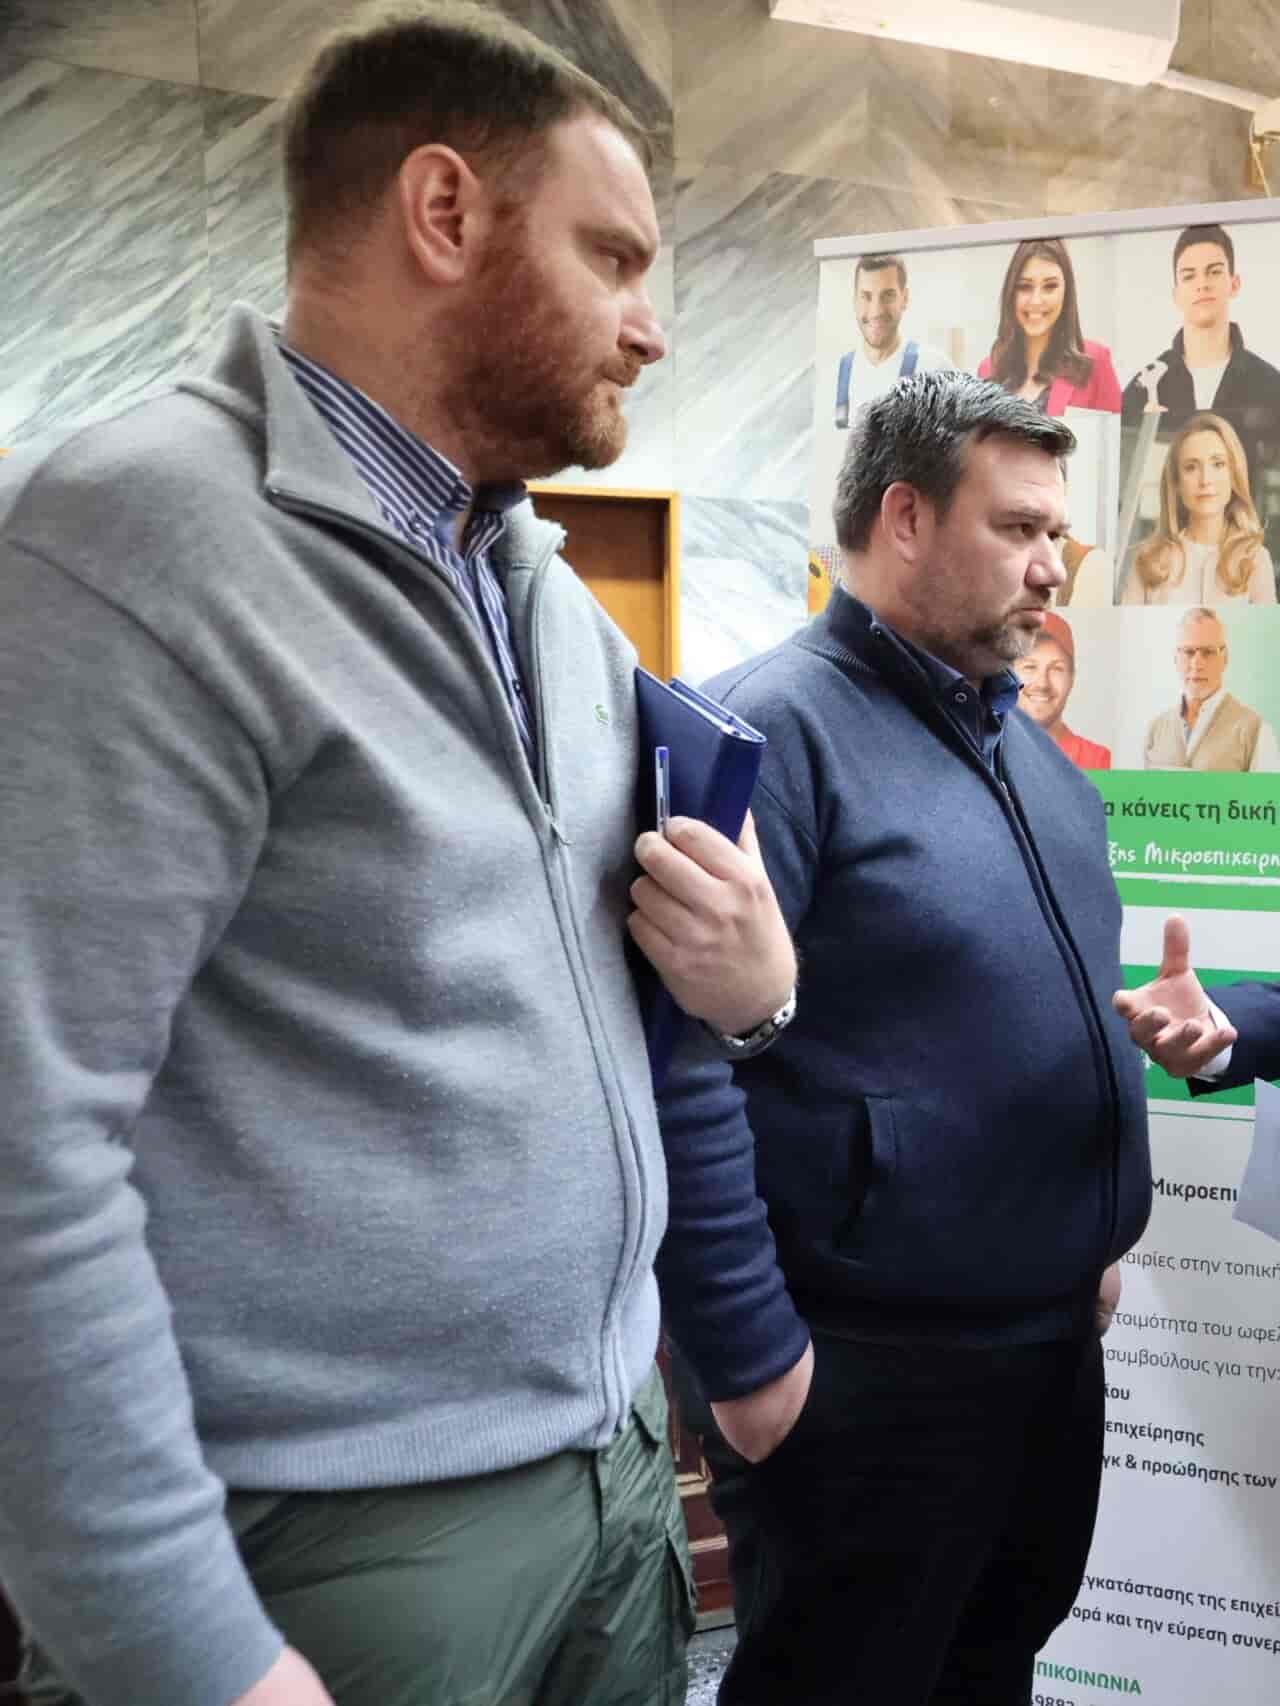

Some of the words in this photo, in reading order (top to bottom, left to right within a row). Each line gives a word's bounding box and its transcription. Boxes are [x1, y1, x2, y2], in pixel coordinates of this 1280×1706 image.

[1122, 796, 1191, 823] κάνεις
[1195, 803, 1221, 825] τη
[1228, 799, 1276, 826] δική
[1121, 1251, 1176, 1272] αιρίες
[1180, 1257, 1221, 1275] στην
[1202, 1322, 1233, 1337] του
[1105, 1348, 1210, 1375] συμβούλους
[1214, 1361, 1241, 1378] για
[1247, 1365, 1280, 1384] την:
[1105, 1420, 1206, 1448] επιχείρησης
[1125, 1454, 1138, 1469] &
[1142, 1460, 1240, 1487] προώθησης
[1243, 1472, 1277, 1489] των
[1083, 1576, 1194, 1606] γκατάστασης
[1197, 1593, 1227, 1612] της
[1106, 1611, 1132, 1628] και
[1135, 1616, 1163, 1634] την
[1167, 1621, 1227, 1647] εύρεση
[1036, 1661, 1142, 1695] ΠΙΚΟΙΝΩΝΙΑ
